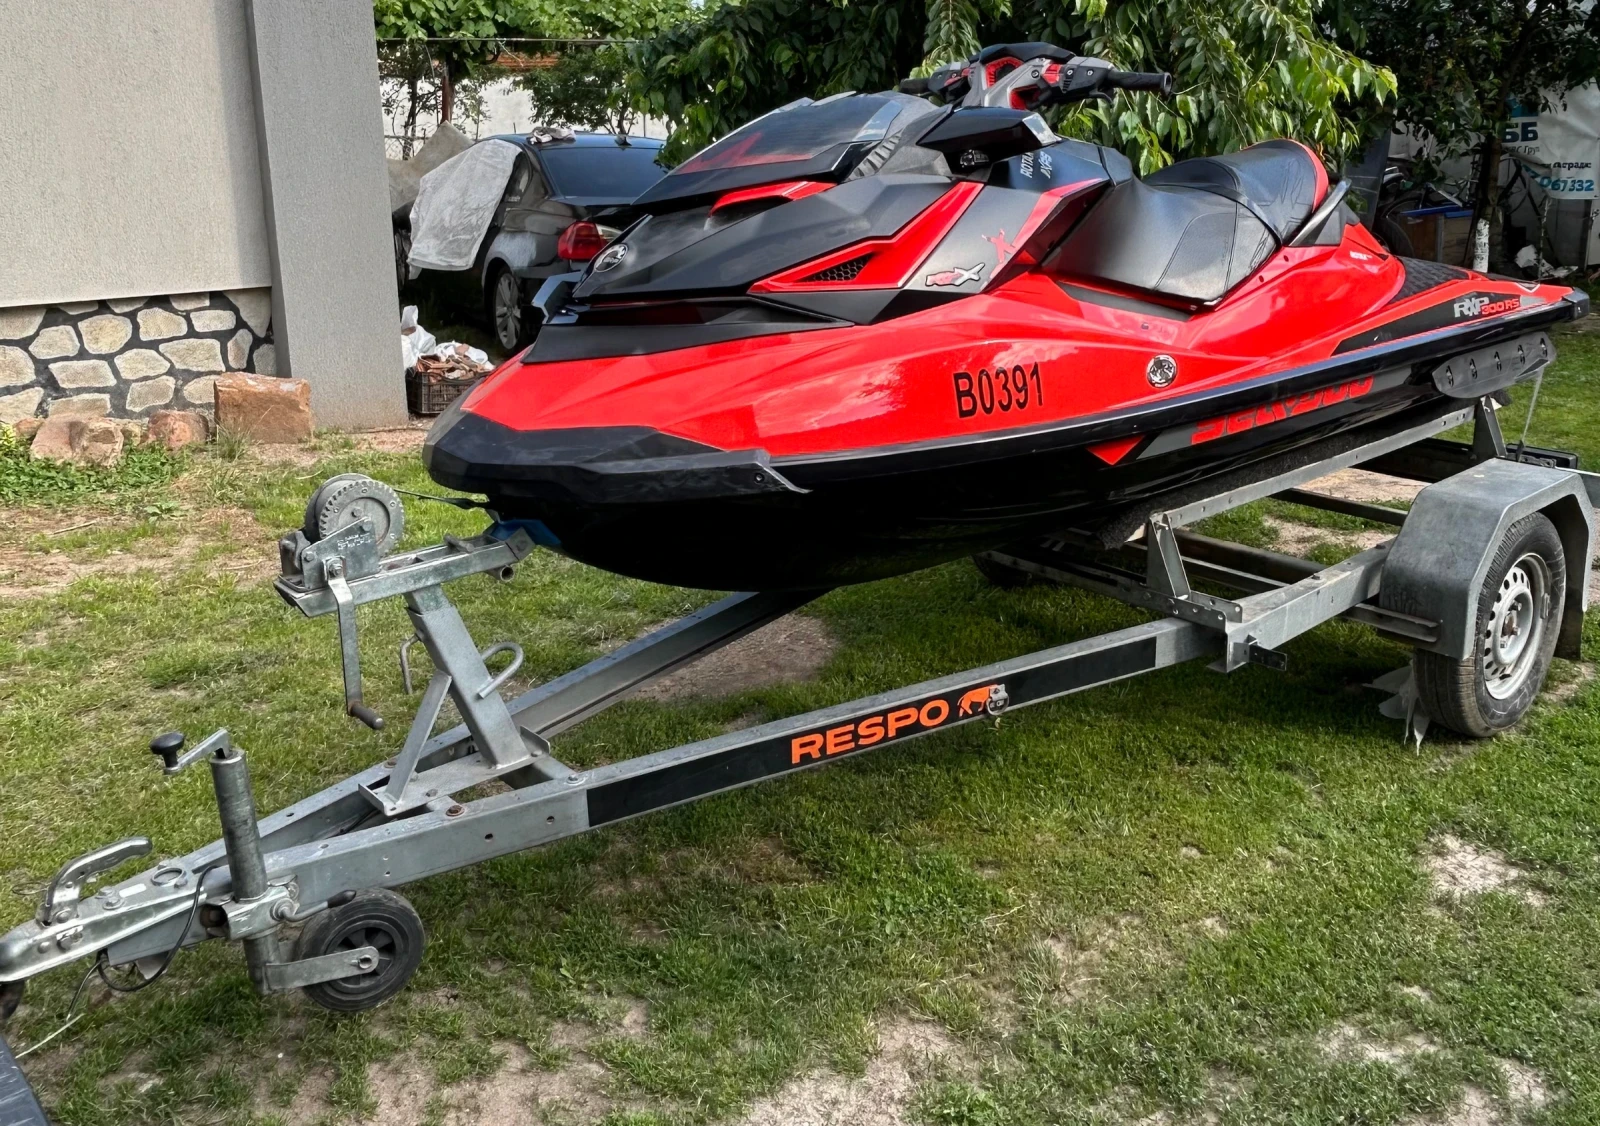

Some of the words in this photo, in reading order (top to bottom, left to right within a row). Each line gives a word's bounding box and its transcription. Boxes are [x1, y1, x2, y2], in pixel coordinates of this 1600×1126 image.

[1481, 301, 1504, 315] 300
[1505, 299, 1520, 310] RS
[953, 362, 1043, 418] B0391
[791, 699, 950, 765] RESPO
